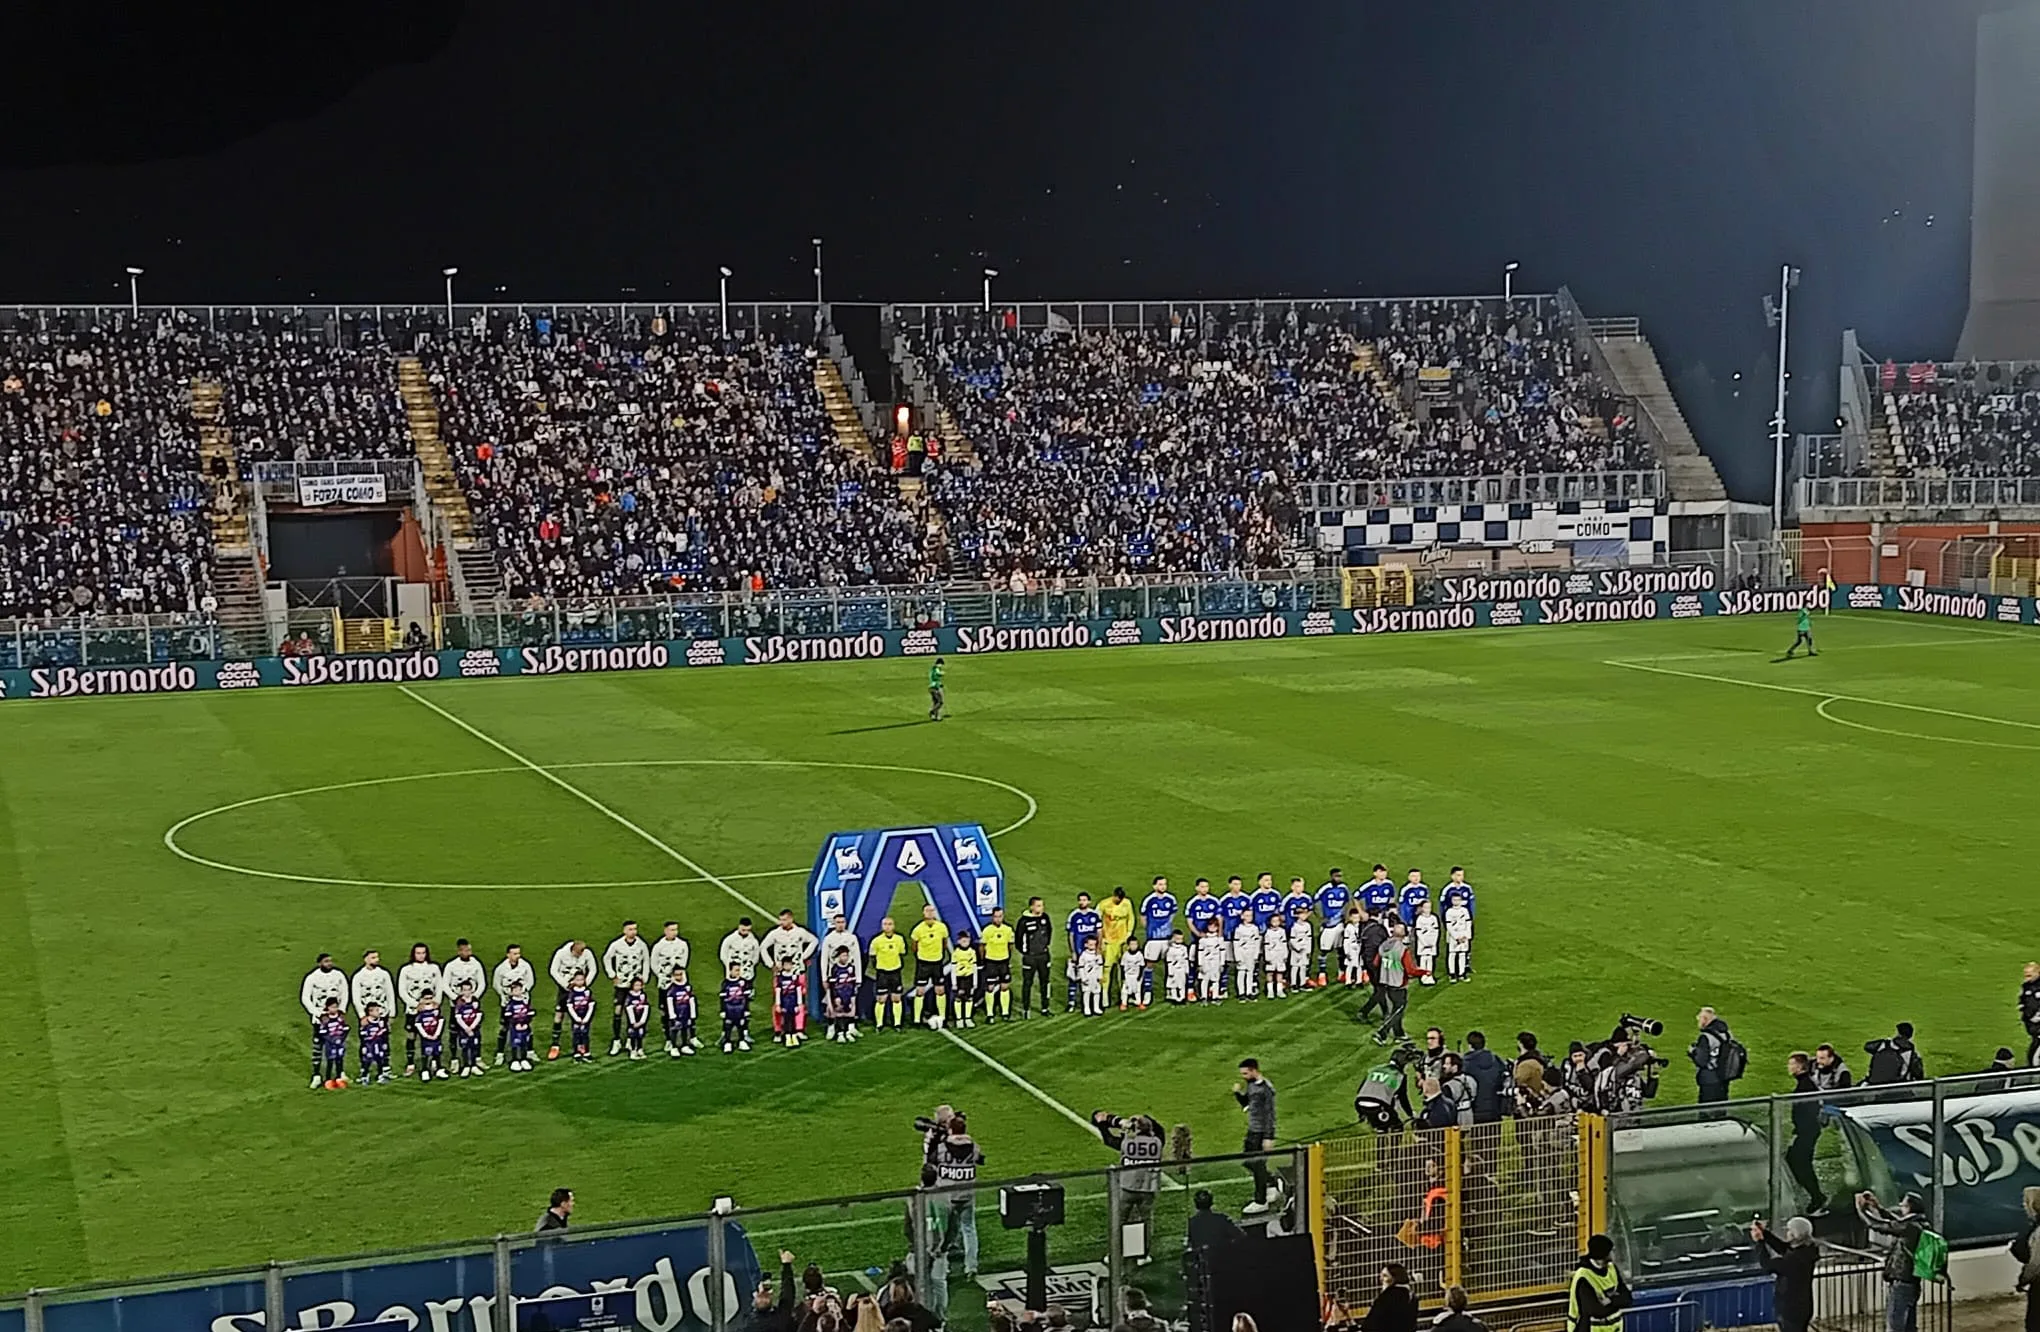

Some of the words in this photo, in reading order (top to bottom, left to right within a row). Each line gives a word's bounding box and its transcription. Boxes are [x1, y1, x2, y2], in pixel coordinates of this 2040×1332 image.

[313, 487, 343, 502] FORZA
[346, 486, 374, 500] COMO
[1576, 522, 1610, 536] COMO
[1442, 573, 1561, 602] S.Bernardo
[1599, 566, 1714, 595] S.Bernardo
[1717, 585, 1830, 615] S.Bernardo
[1897, 586, 1986, 619] S.Bernardo
[1539, 595, 1656, 624] S.Bernardo
[1352, 604, 1475, 633] S.Bernardo
[908, 630, 932, 638] OGNI
[1159, 612, 1286, 643] S.Bernardo
[901, 637, 938, 647] GOCCIA
[956, 621, 1089, 652] S.Bernardo
[692, 640, 719, 648] OGNI
[744, 631, 884, 663] S.Bernardo
[903, 645, 937, 654] CONTA
[465, 650, 493, 659] OGNI
[521, 640, 668, 674] S.Bernardo
[685, 648, 725, 657] GOCCIA
[223, 662, 253, 671] OGNI
[459, 658, 500, 668] GOCCIA
[688, 656, 723, 665] CONTA
[216, 670, 261, 680] GOCCIA
[282, 651, 439, 685] S.Bernardo
[462, 666, 499, 676] CONTA
[30, 662, 195, 697] S.Bernardo
[219, 679, 259, 688] CONTA
[1152, 909, 1170, 917] Uber
[1372, 1072, 1389, 1083] TV
[1127, 1141, 1158, 1156] 050
